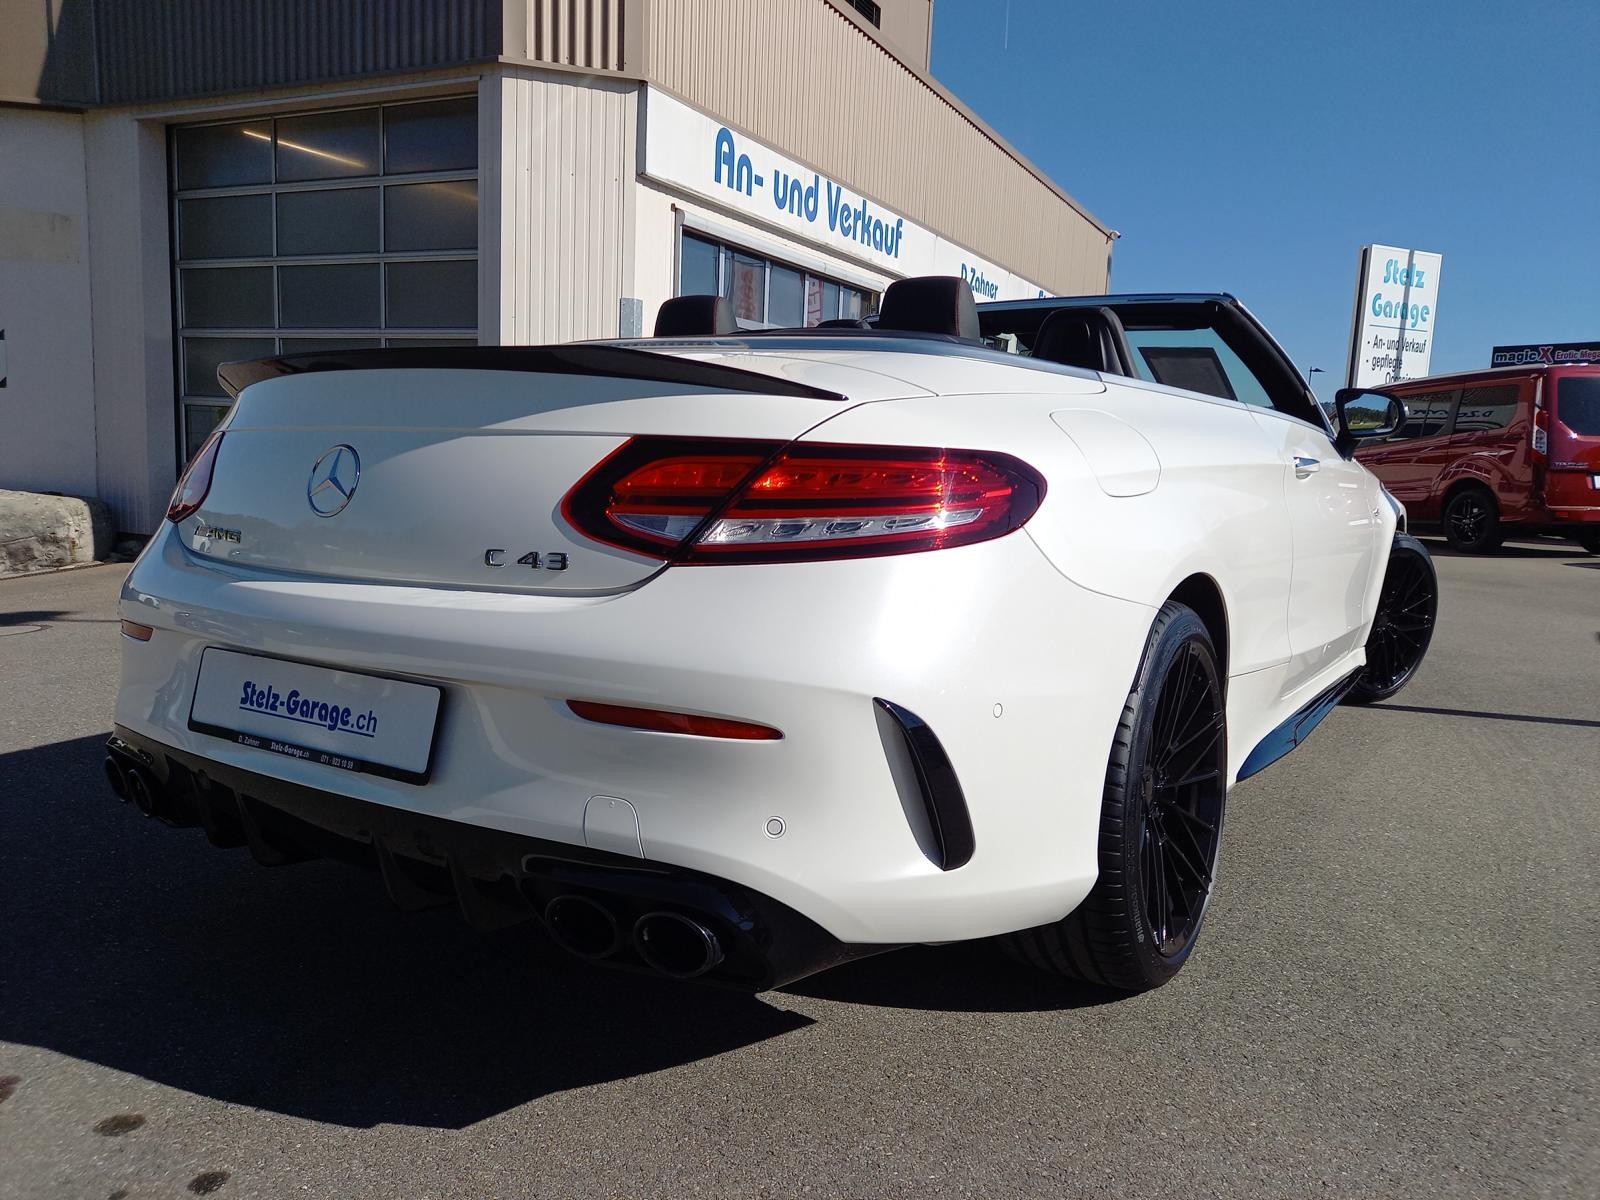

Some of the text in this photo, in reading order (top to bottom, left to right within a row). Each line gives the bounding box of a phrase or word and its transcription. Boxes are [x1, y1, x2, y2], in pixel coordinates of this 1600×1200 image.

[714, 127, 903, 258] An- und Verkauf
[969, 267, 999, 300] Zahner
[1383, 258, 1425, 289] Stelz
[1371, 293, 1430, 328] Garage
[1373, 334, 1427, 353] An- und Verkauf
[1372, 354, 1402, 373] gepflegte
[484, 548, 570, 572] C 43
[240, 680, 378, 733] Stelz-Garage.ch
[270, 742, 310, 758] Stelz-Garage.ch
